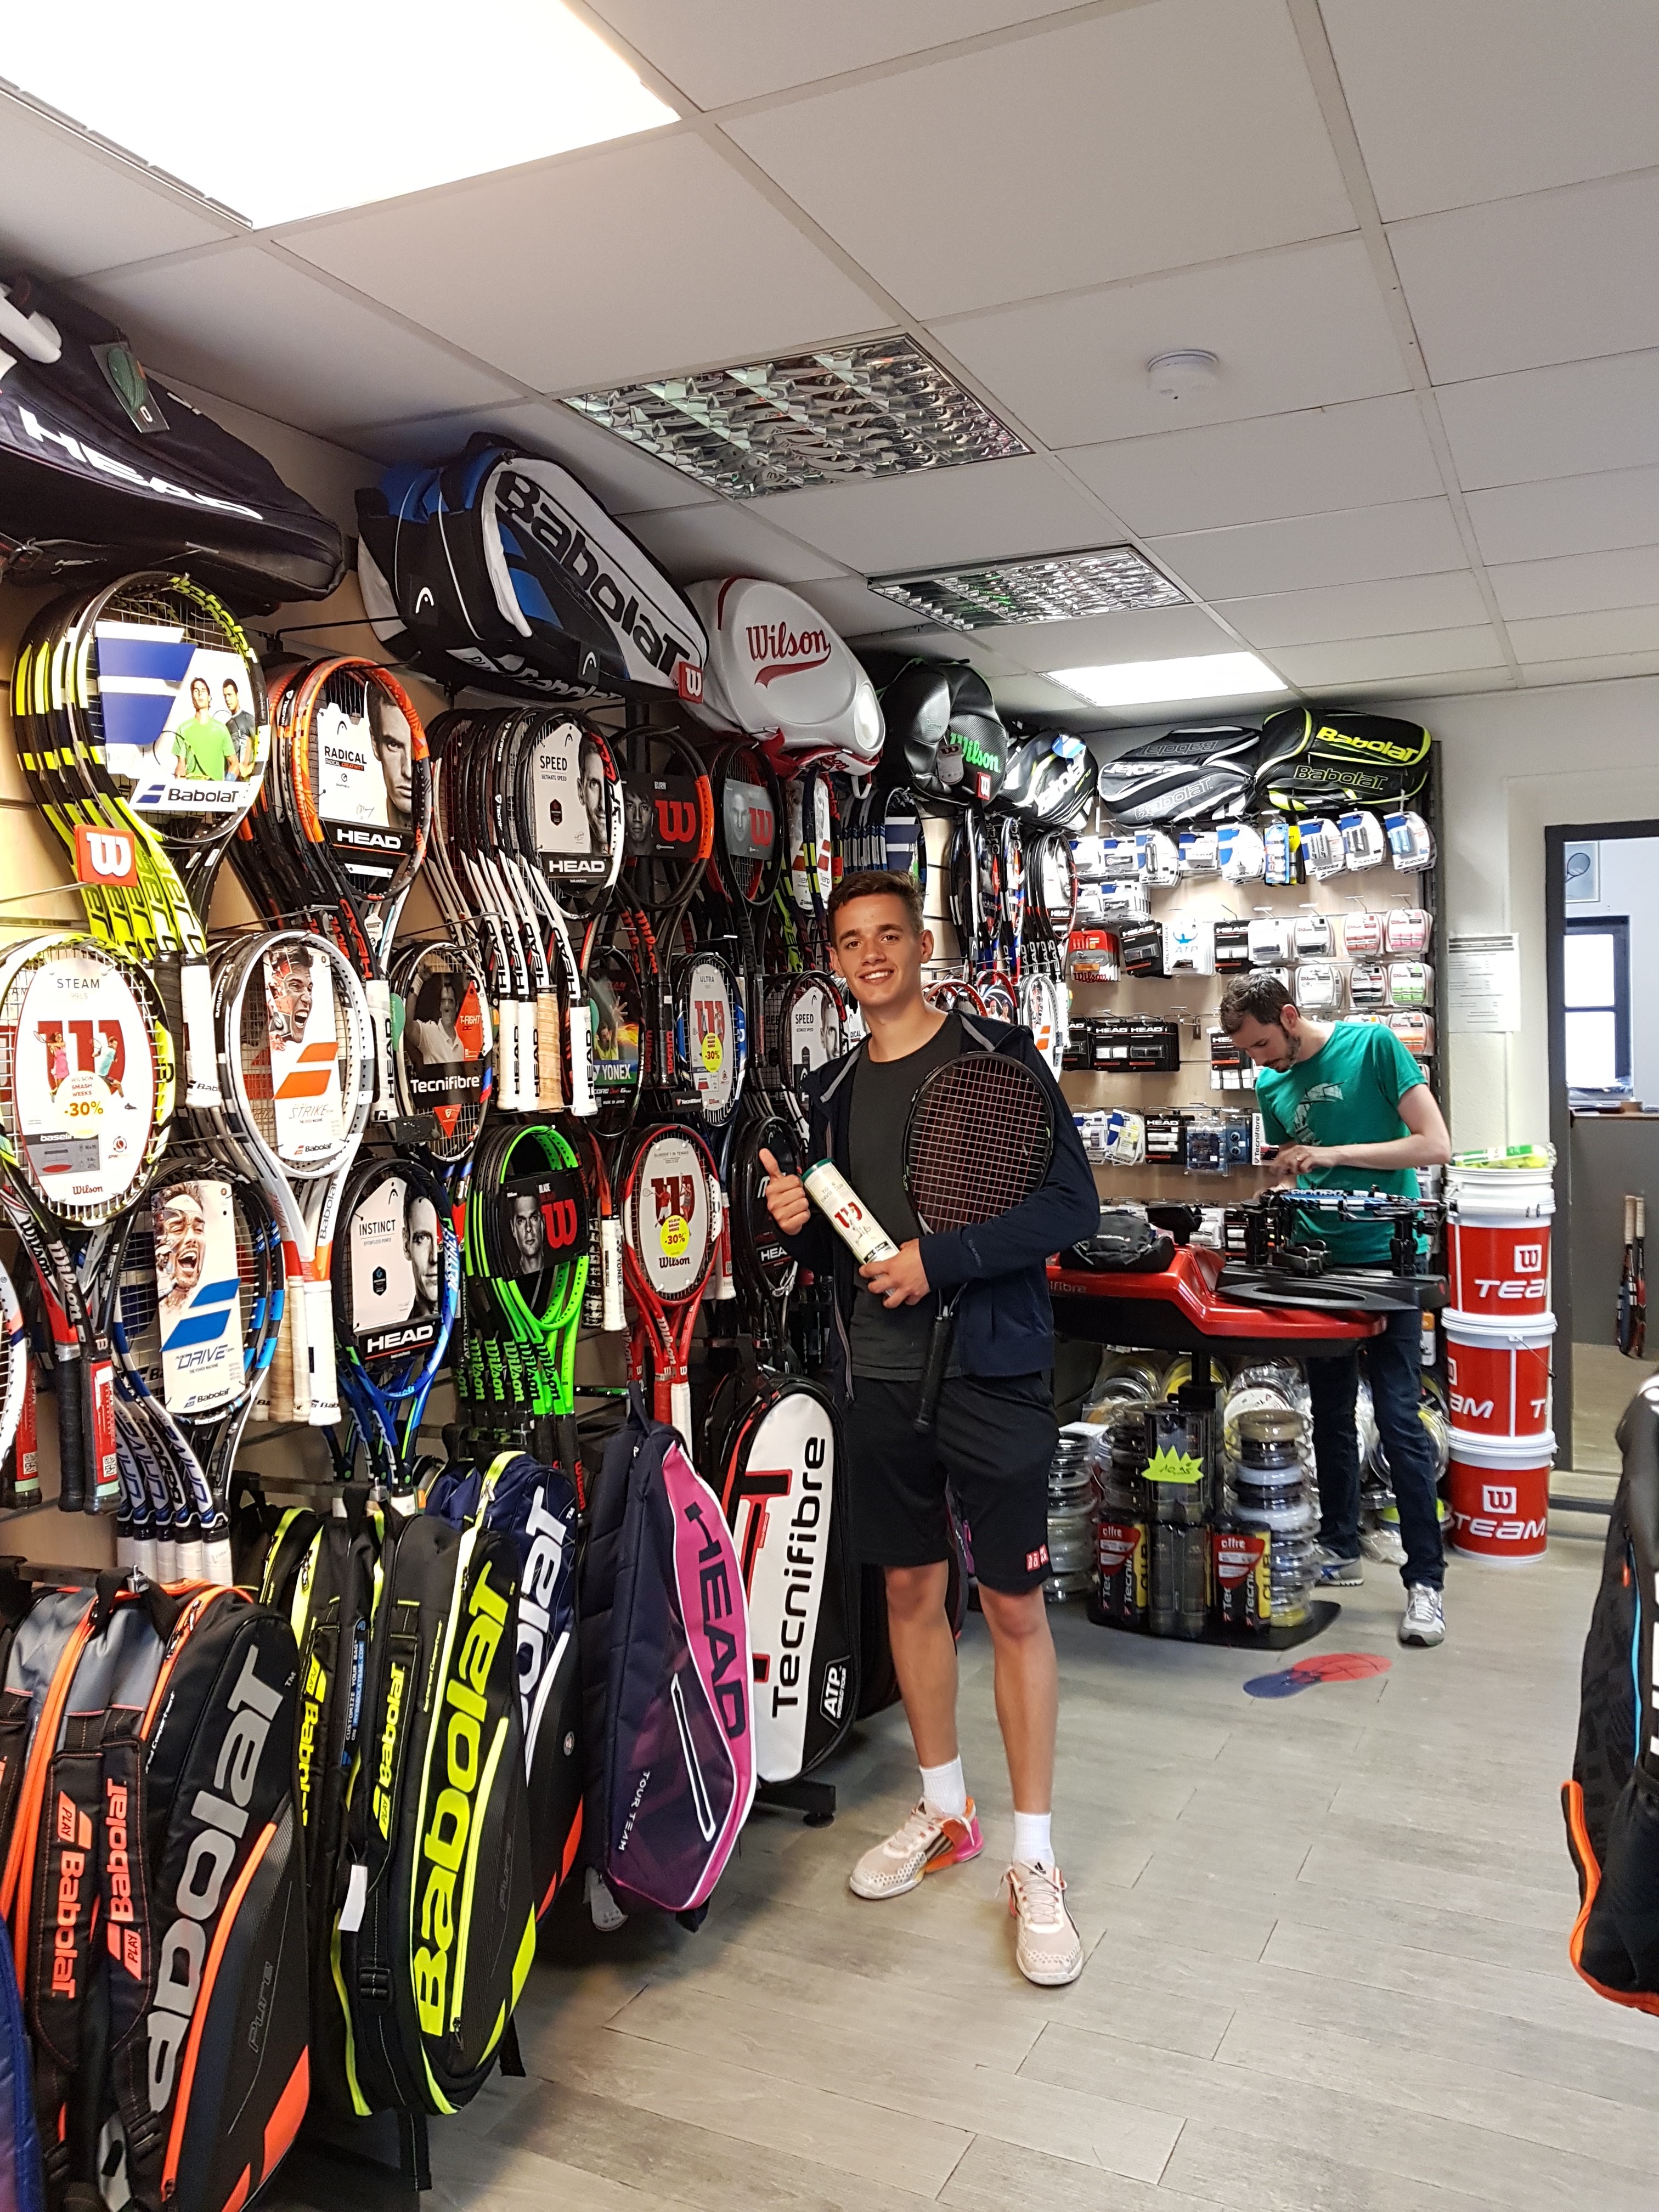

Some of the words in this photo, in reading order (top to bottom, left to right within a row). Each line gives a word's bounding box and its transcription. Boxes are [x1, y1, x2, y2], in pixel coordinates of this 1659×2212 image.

[746, 622, 832, 661] Wilson
[324, 746, 367, 764] RADICAL
[950, 733, 1001, 773] Wilson
[540, 755, 567, 771] SPEED
[654, 781, 667, 789] BURN
[337, 829, 401, 849] HEAD
[549, 860, 605, 873] HEAD
[1122, 926, 1154, 937] HEAD
[486, 920, 506, 989] HEAD
[504, 921, 524, 990] HEAD
[524, 922, 544, 986] HEAD
[553, 927, 576, 994] HEAD
[57, 979, 99, 989] STEAM
[1074, 972, 1107, 983] Wilson
[460, 1015, 481, 1024] T-FIGHT
[795, 1014, 814, 1024] SPEED
[705, 1051, 720, 1060] -30%
[602, 1064, 631, 1080] YONEX
[410, 1075, 480, 1093] Tecnifibre
[64, 1101, 103, 1116] -30%
[289, 1104, 329, 1119] STRIKE
[73, 1185, 104, 1195] Wilson
[359, 1219, 396, 1236] INSTINCT
[665, 1234, 686, 1245] -30%
[659, 1256, 690, 1268] Wilson
[761, 1247, 788, 1261] HEA
[368, 1325, 433, 1353] HEAD
[178, 1344, 228, 1370] DRIVE
[772, 1436, 826, 1718] Tecnifibre
[684, 1502, 746, 1740] HEAD
[308, 1666, 318, 1690] PLAY
[824, 1667, 840, 1718] ATP
[346, 1694, 356, 1741] CUSTOMIZE
[351, 1728, 356, 1741] ON
[631, 1770, 650, 1808] TOUR
[61, 1809, 74, 1837] PLAY
[618, 1810, 637, 1852] TEAM
[128, 1935, 138, 1963] PLAY
